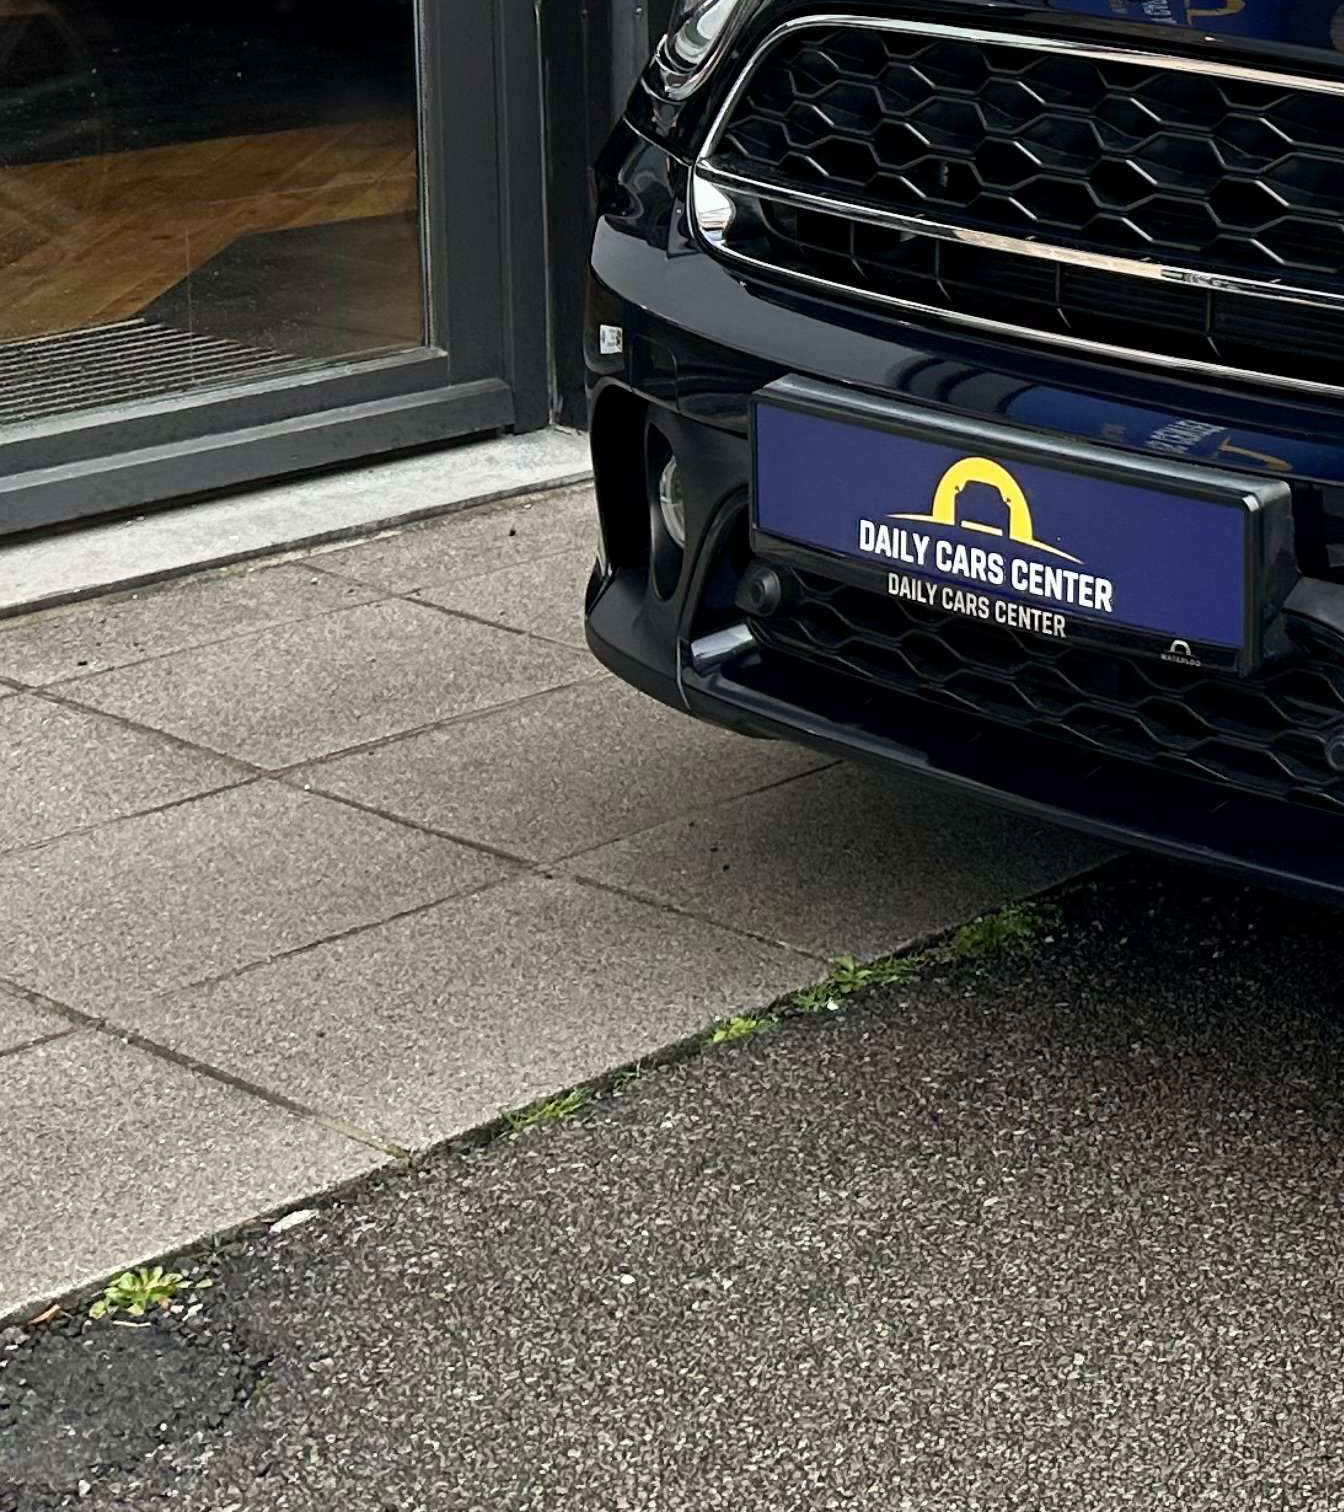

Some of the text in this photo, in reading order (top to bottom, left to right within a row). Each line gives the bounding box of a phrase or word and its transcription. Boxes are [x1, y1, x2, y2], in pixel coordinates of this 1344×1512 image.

[859, 519, 1114, 613] DAILY CARS CENTER
[888, 573, 1068, 638] DAILY CARS CENTER
